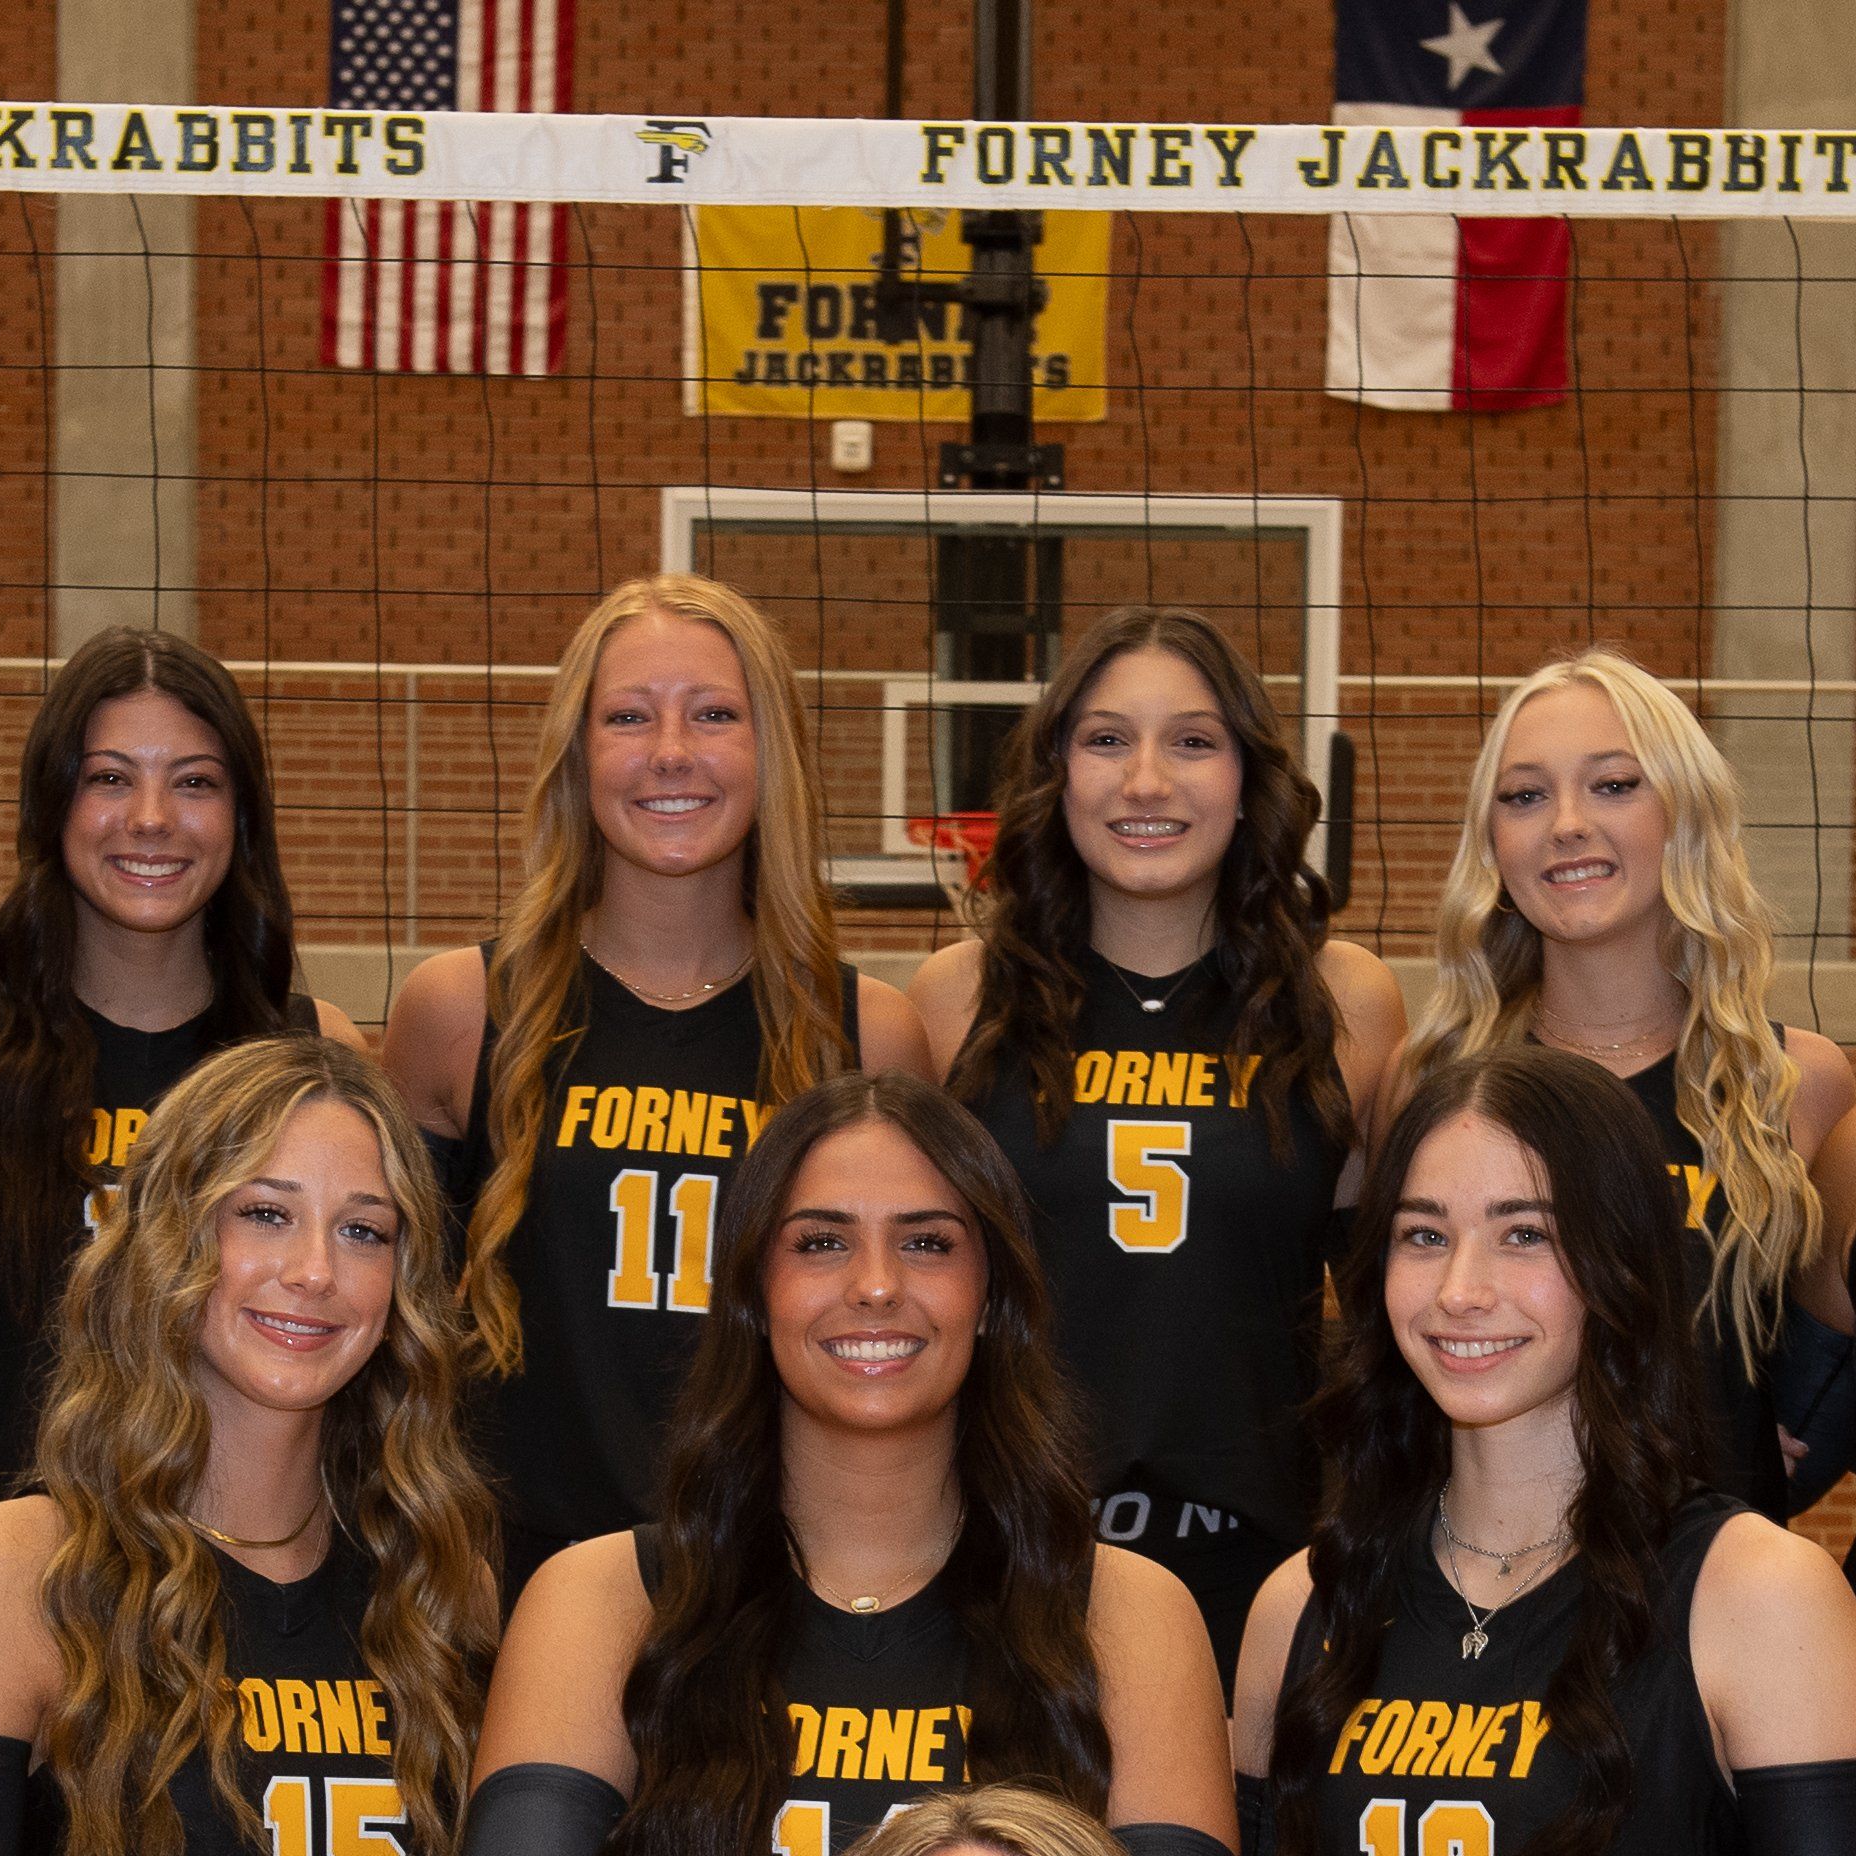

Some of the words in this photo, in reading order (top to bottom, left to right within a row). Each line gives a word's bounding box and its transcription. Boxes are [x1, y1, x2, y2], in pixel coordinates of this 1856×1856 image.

[919, 124, 1256, 187] FORNEY
[1074, 1050, 1263, 1108] ORNEY
[1107, 1119, 1192, 1254] 5
[607, 1168, 720, 1314] 11
[238, 1678, 392, 1756] ORNE
[1329, 1699, 1550, 1779] FORNEY
